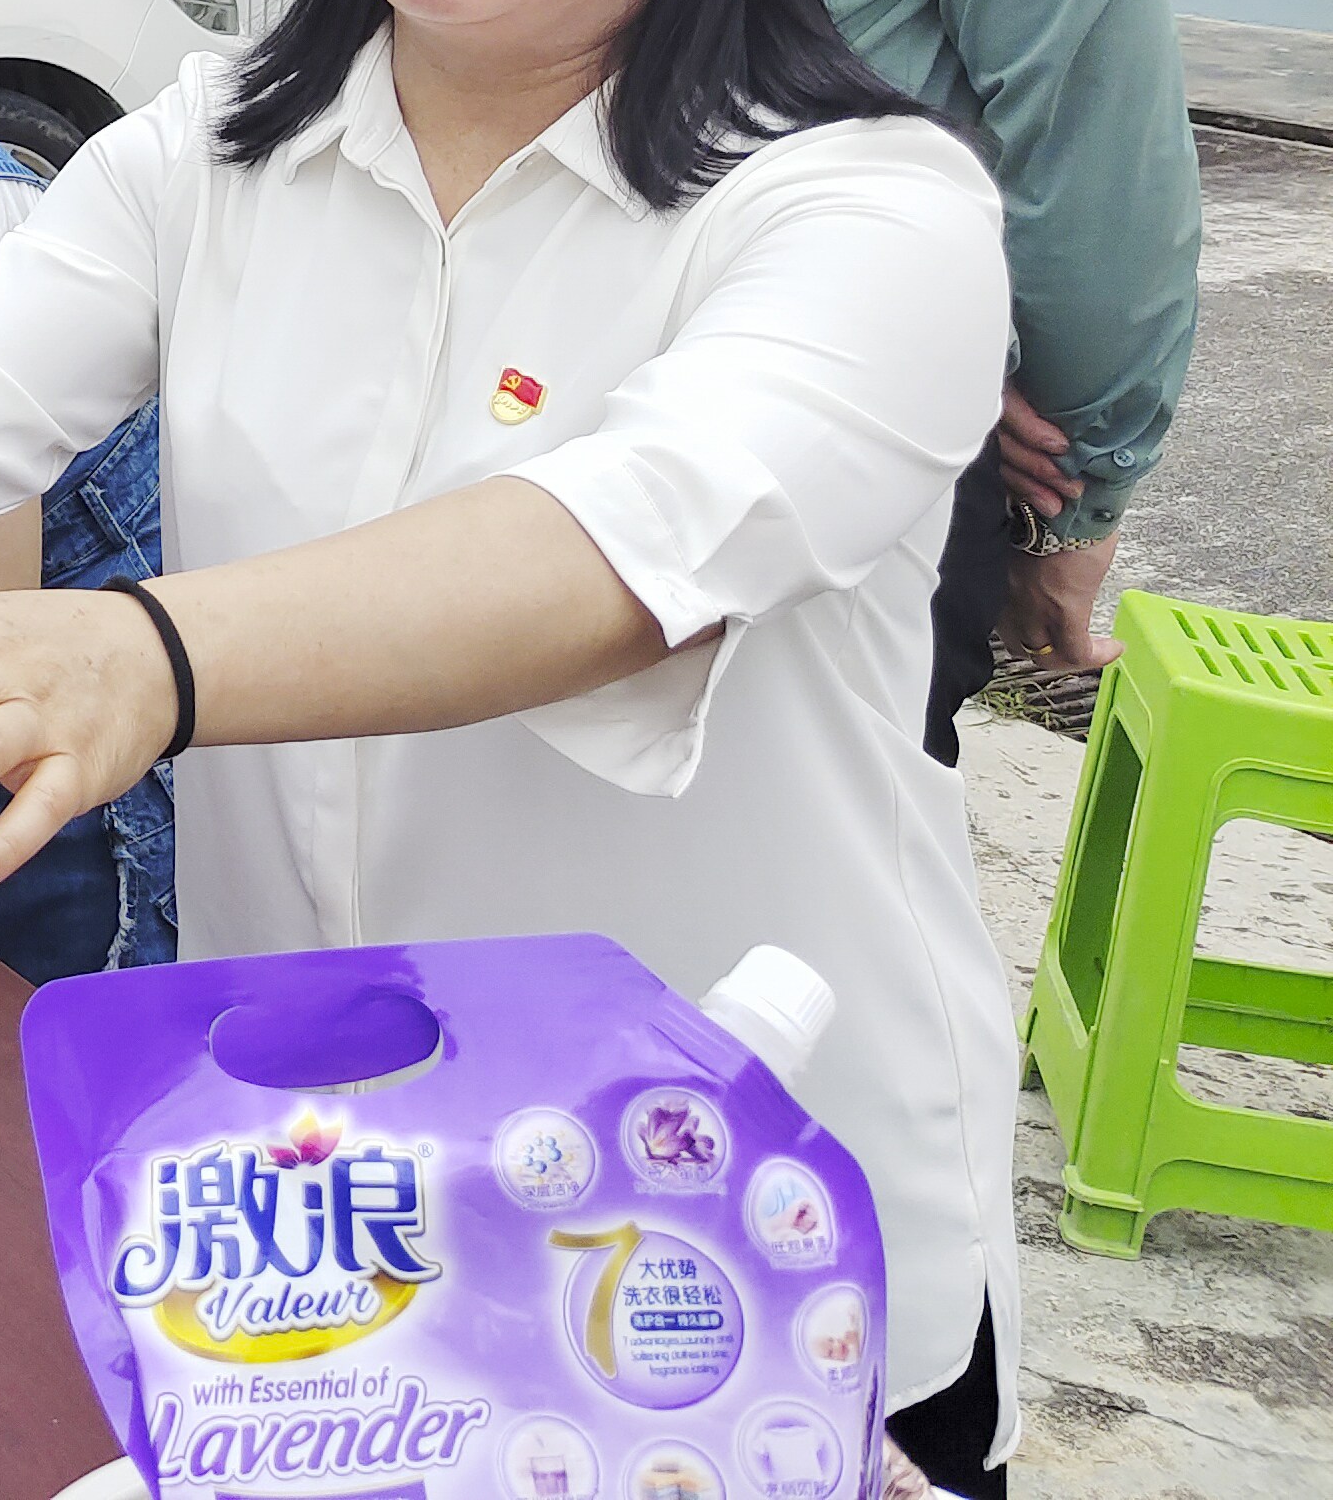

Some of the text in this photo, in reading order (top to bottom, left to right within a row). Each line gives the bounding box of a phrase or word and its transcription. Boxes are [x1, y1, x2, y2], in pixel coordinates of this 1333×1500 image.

[114, 1146, 433, 1296] 激浪
[638, 1257, 697, 1280] 大优势
[205, 1281, 375, 1329] Valeur
[548, 1220, 644, 1380] 7
[622, 1284, 724, 1307] 洗衣很轻松
[193, 1366, 390, 1406] with Essential of
[154, 1383, 484, 1479] Lavender
